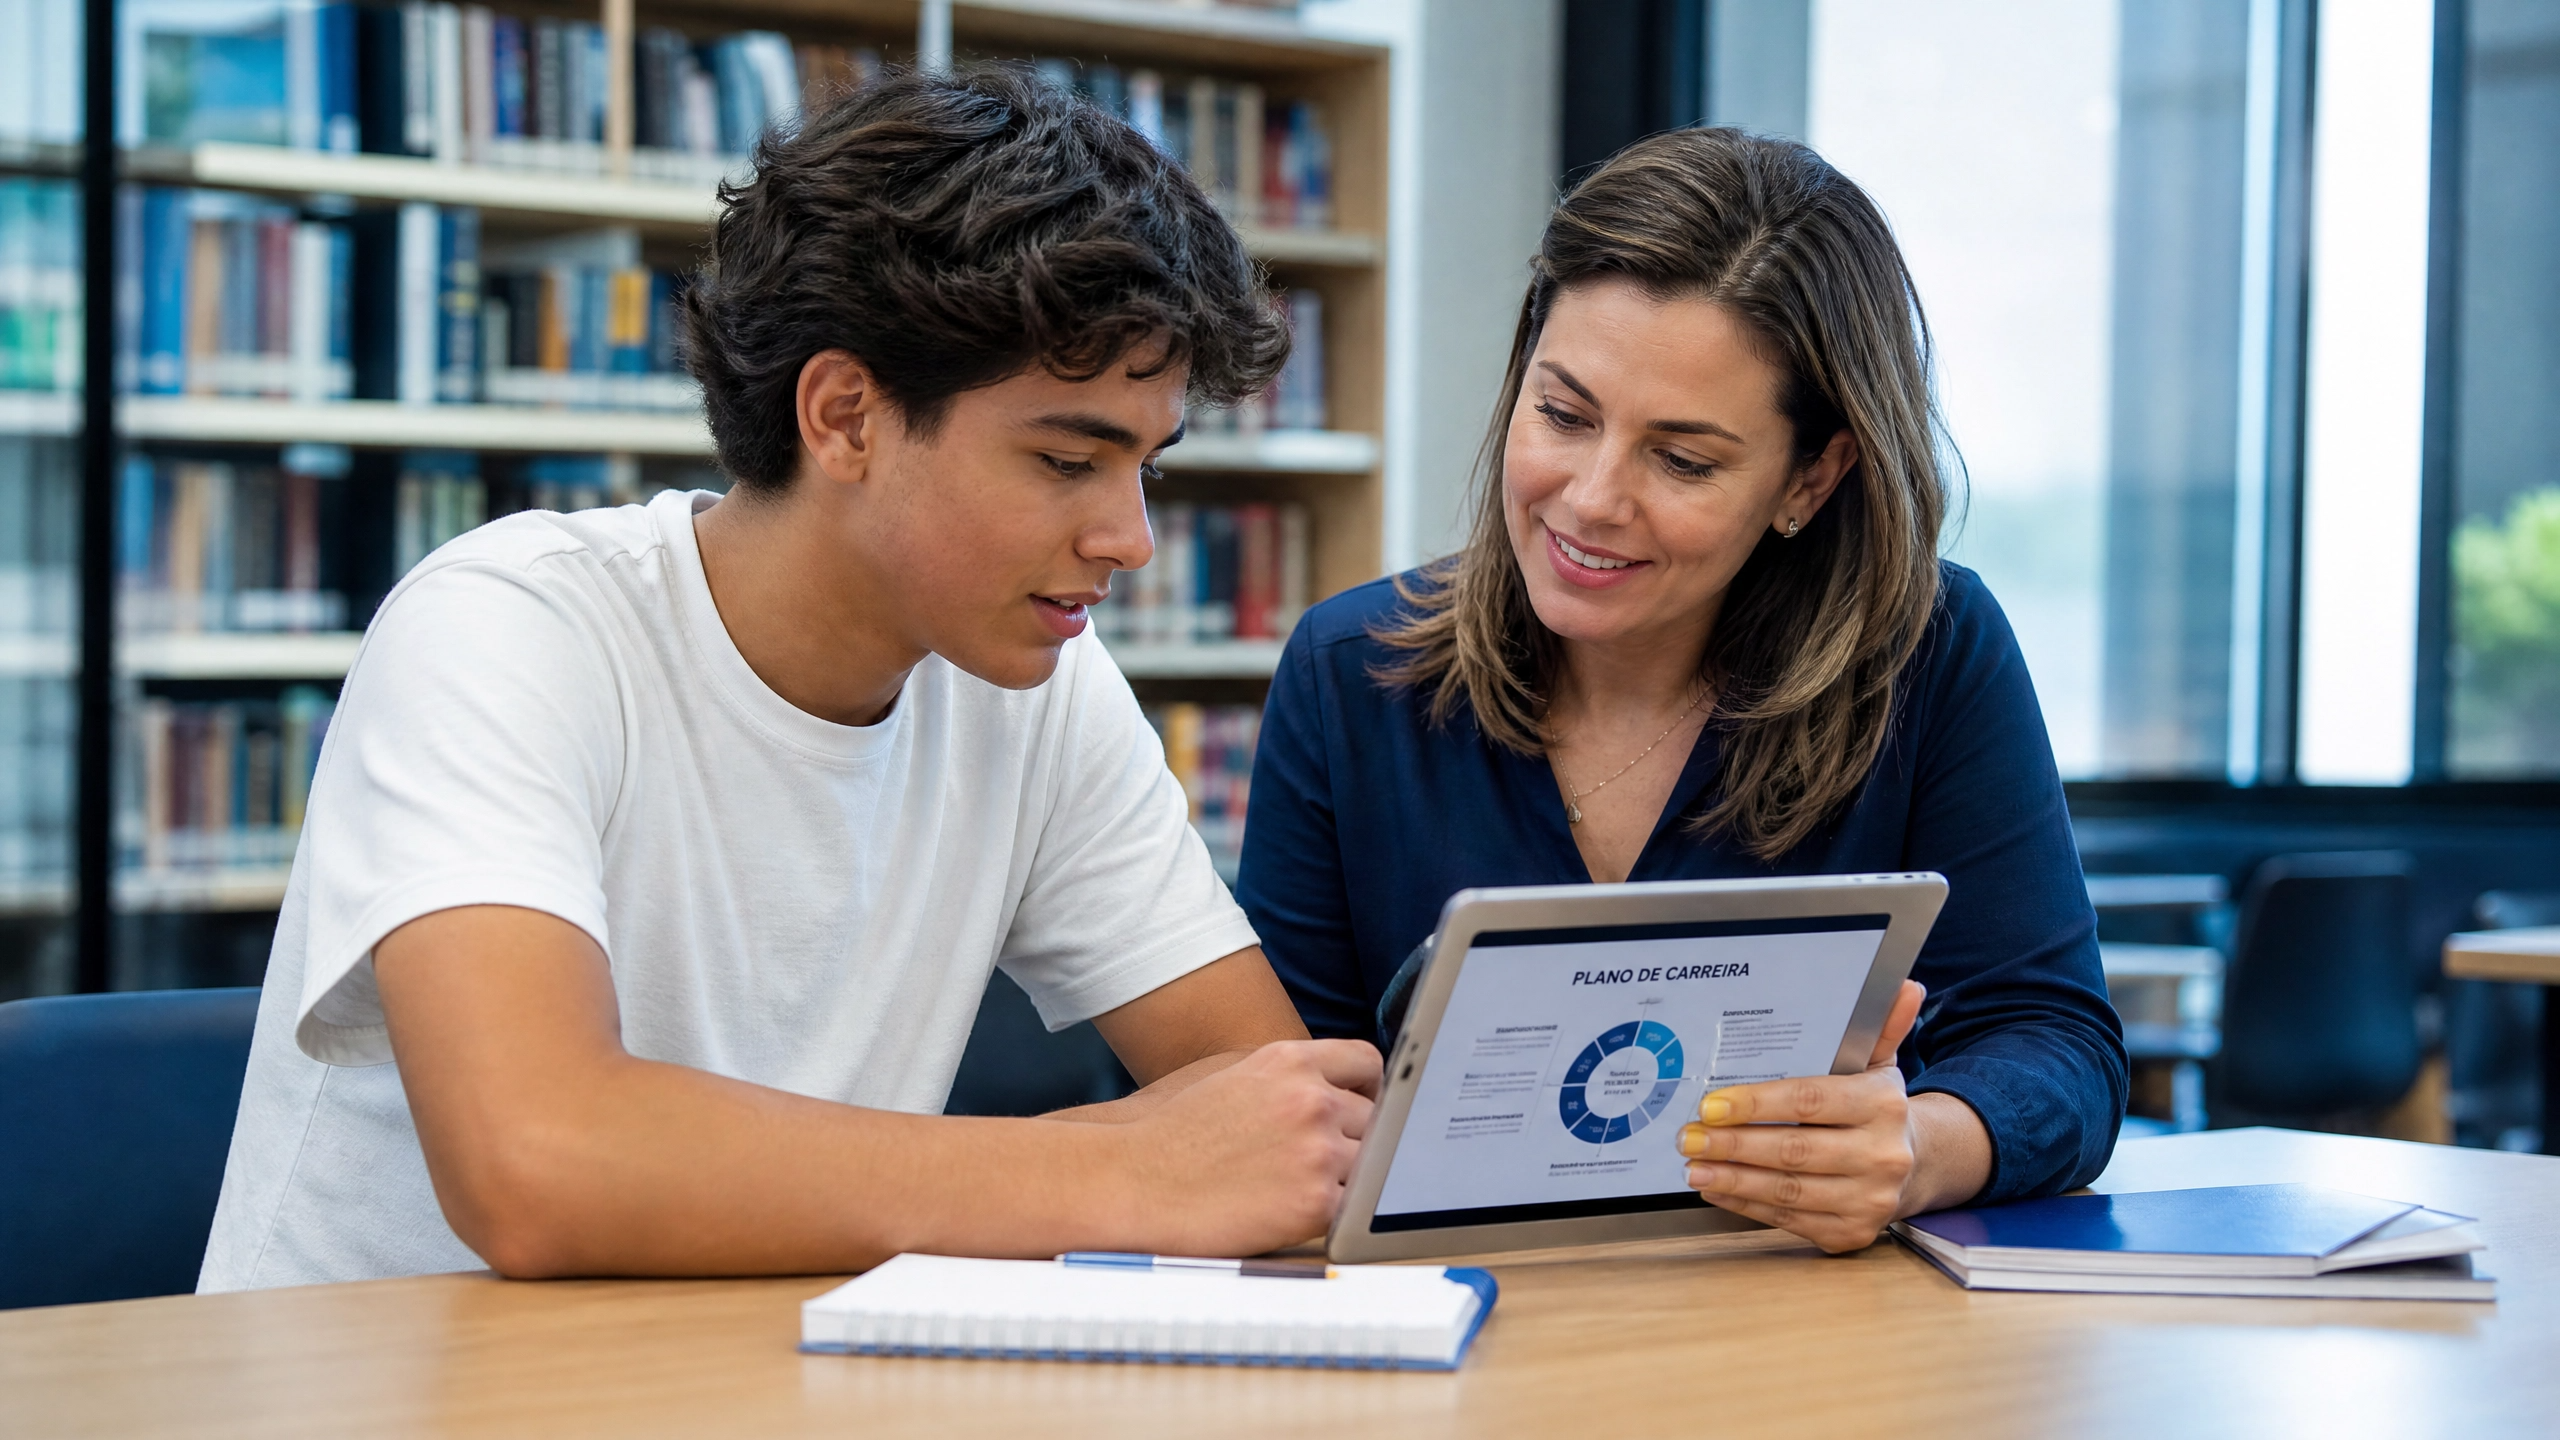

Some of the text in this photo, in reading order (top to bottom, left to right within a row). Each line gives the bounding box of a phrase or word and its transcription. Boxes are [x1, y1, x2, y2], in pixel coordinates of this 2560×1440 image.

[1572, 962, 1749, 985] PLANO DE CARREIRA
